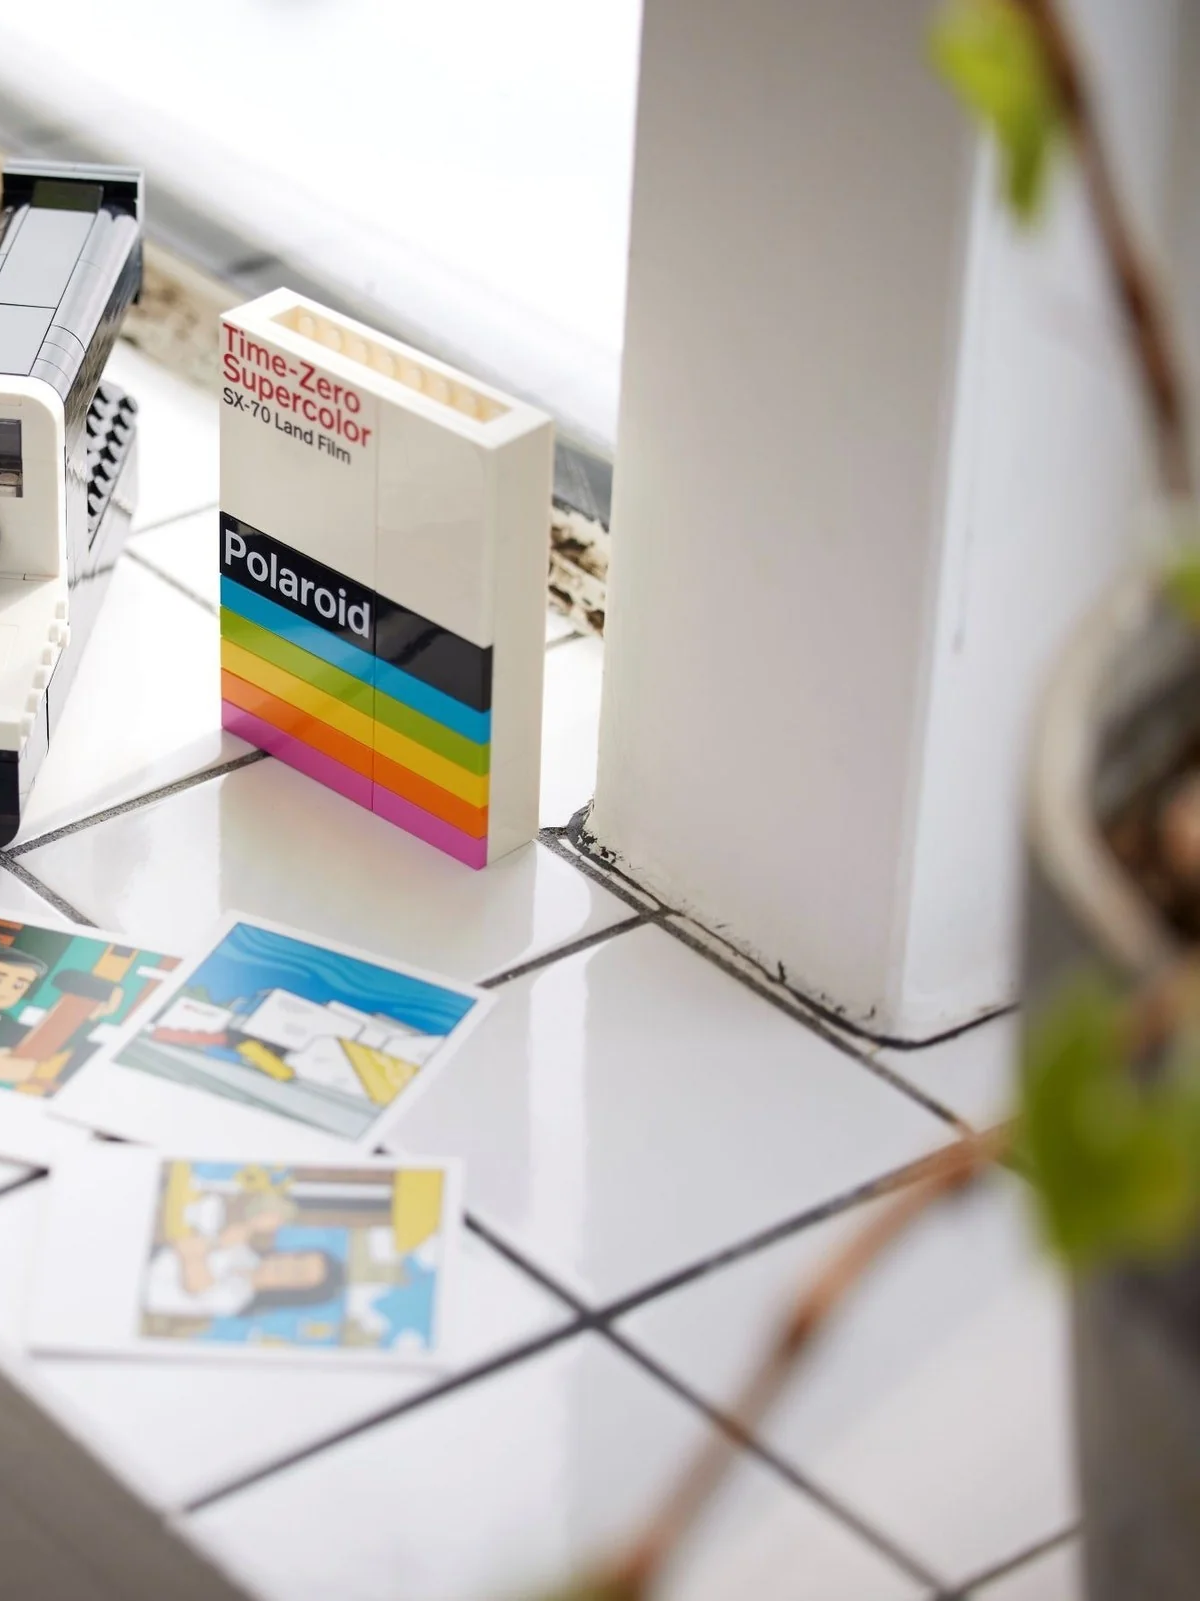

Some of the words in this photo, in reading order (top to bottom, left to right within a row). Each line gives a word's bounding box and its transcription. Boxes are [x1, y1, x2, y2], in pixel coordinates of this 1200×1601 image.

[223, 322, 360, 413] Time-Zero
[223, 353, 372, 447] Supercolor
[223, 387, 270, 424] SX-70
[275, 412, 314, 445] Land
[318, 434, 352, 465] Film
[224, 529, 370, 639] Polaroid
